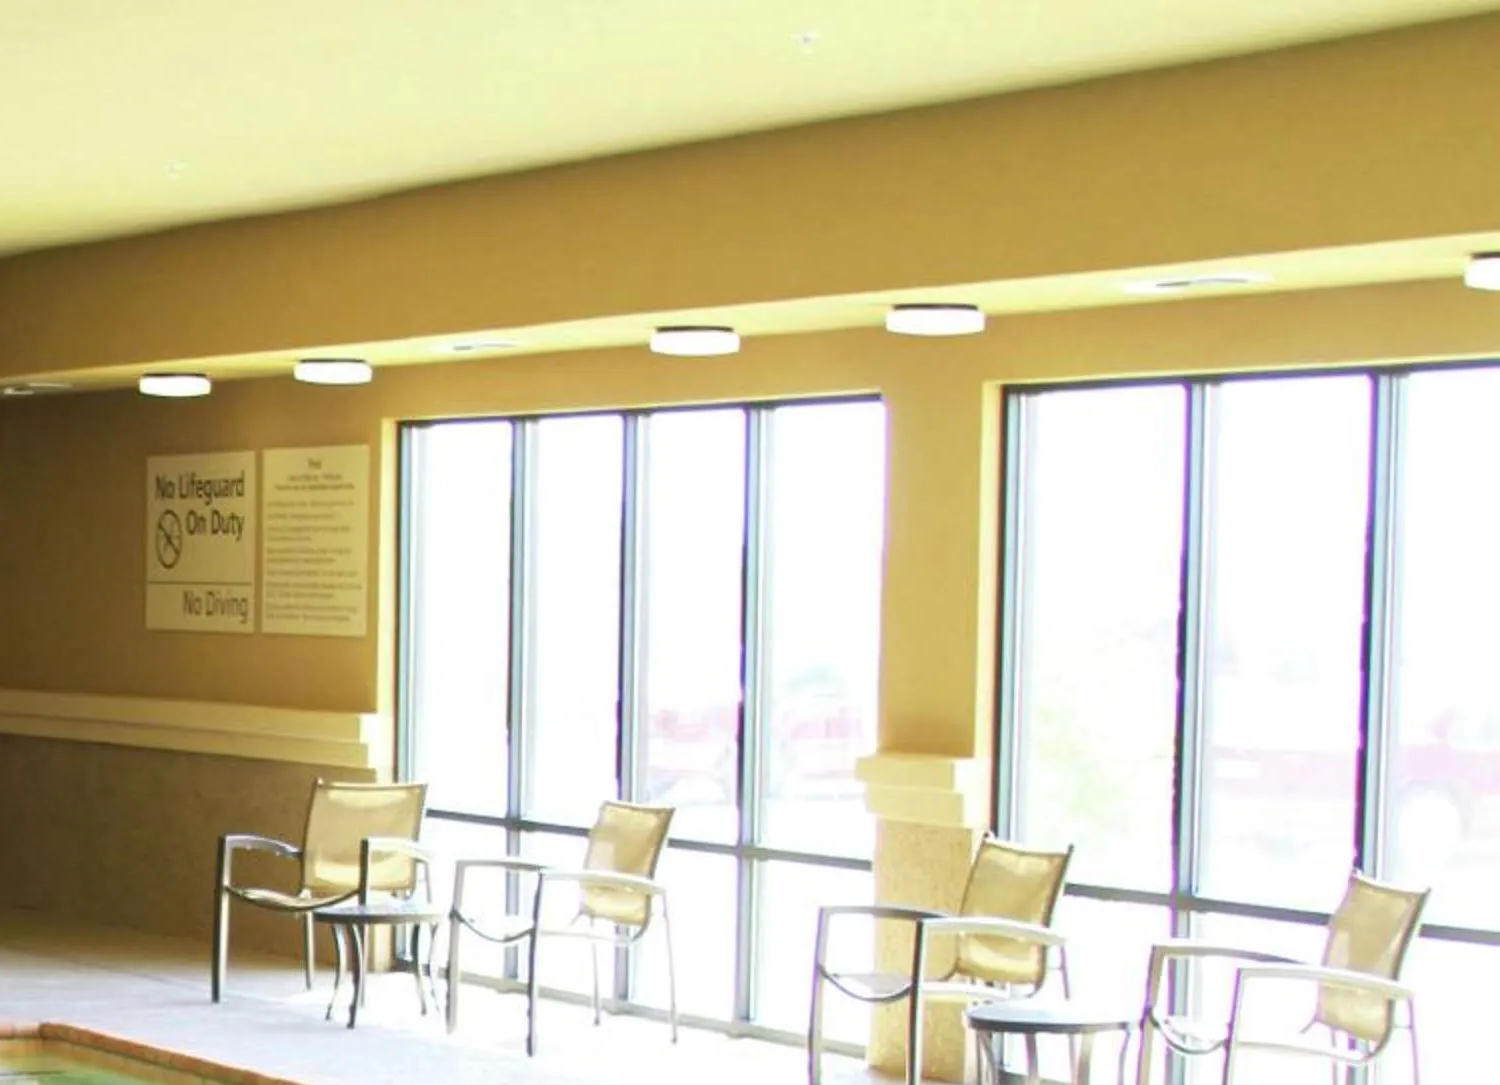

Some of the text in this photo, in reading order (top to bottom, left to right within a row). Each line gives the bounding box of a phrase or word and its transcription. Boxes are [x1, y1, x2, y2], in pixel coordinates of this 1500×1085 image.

[155, 475, 175, 500] No
[178, 471, 245, 505] Lifeguard
[186, 510, 245, 542] On Duty
[182, 590, 249, 624] No Diving
